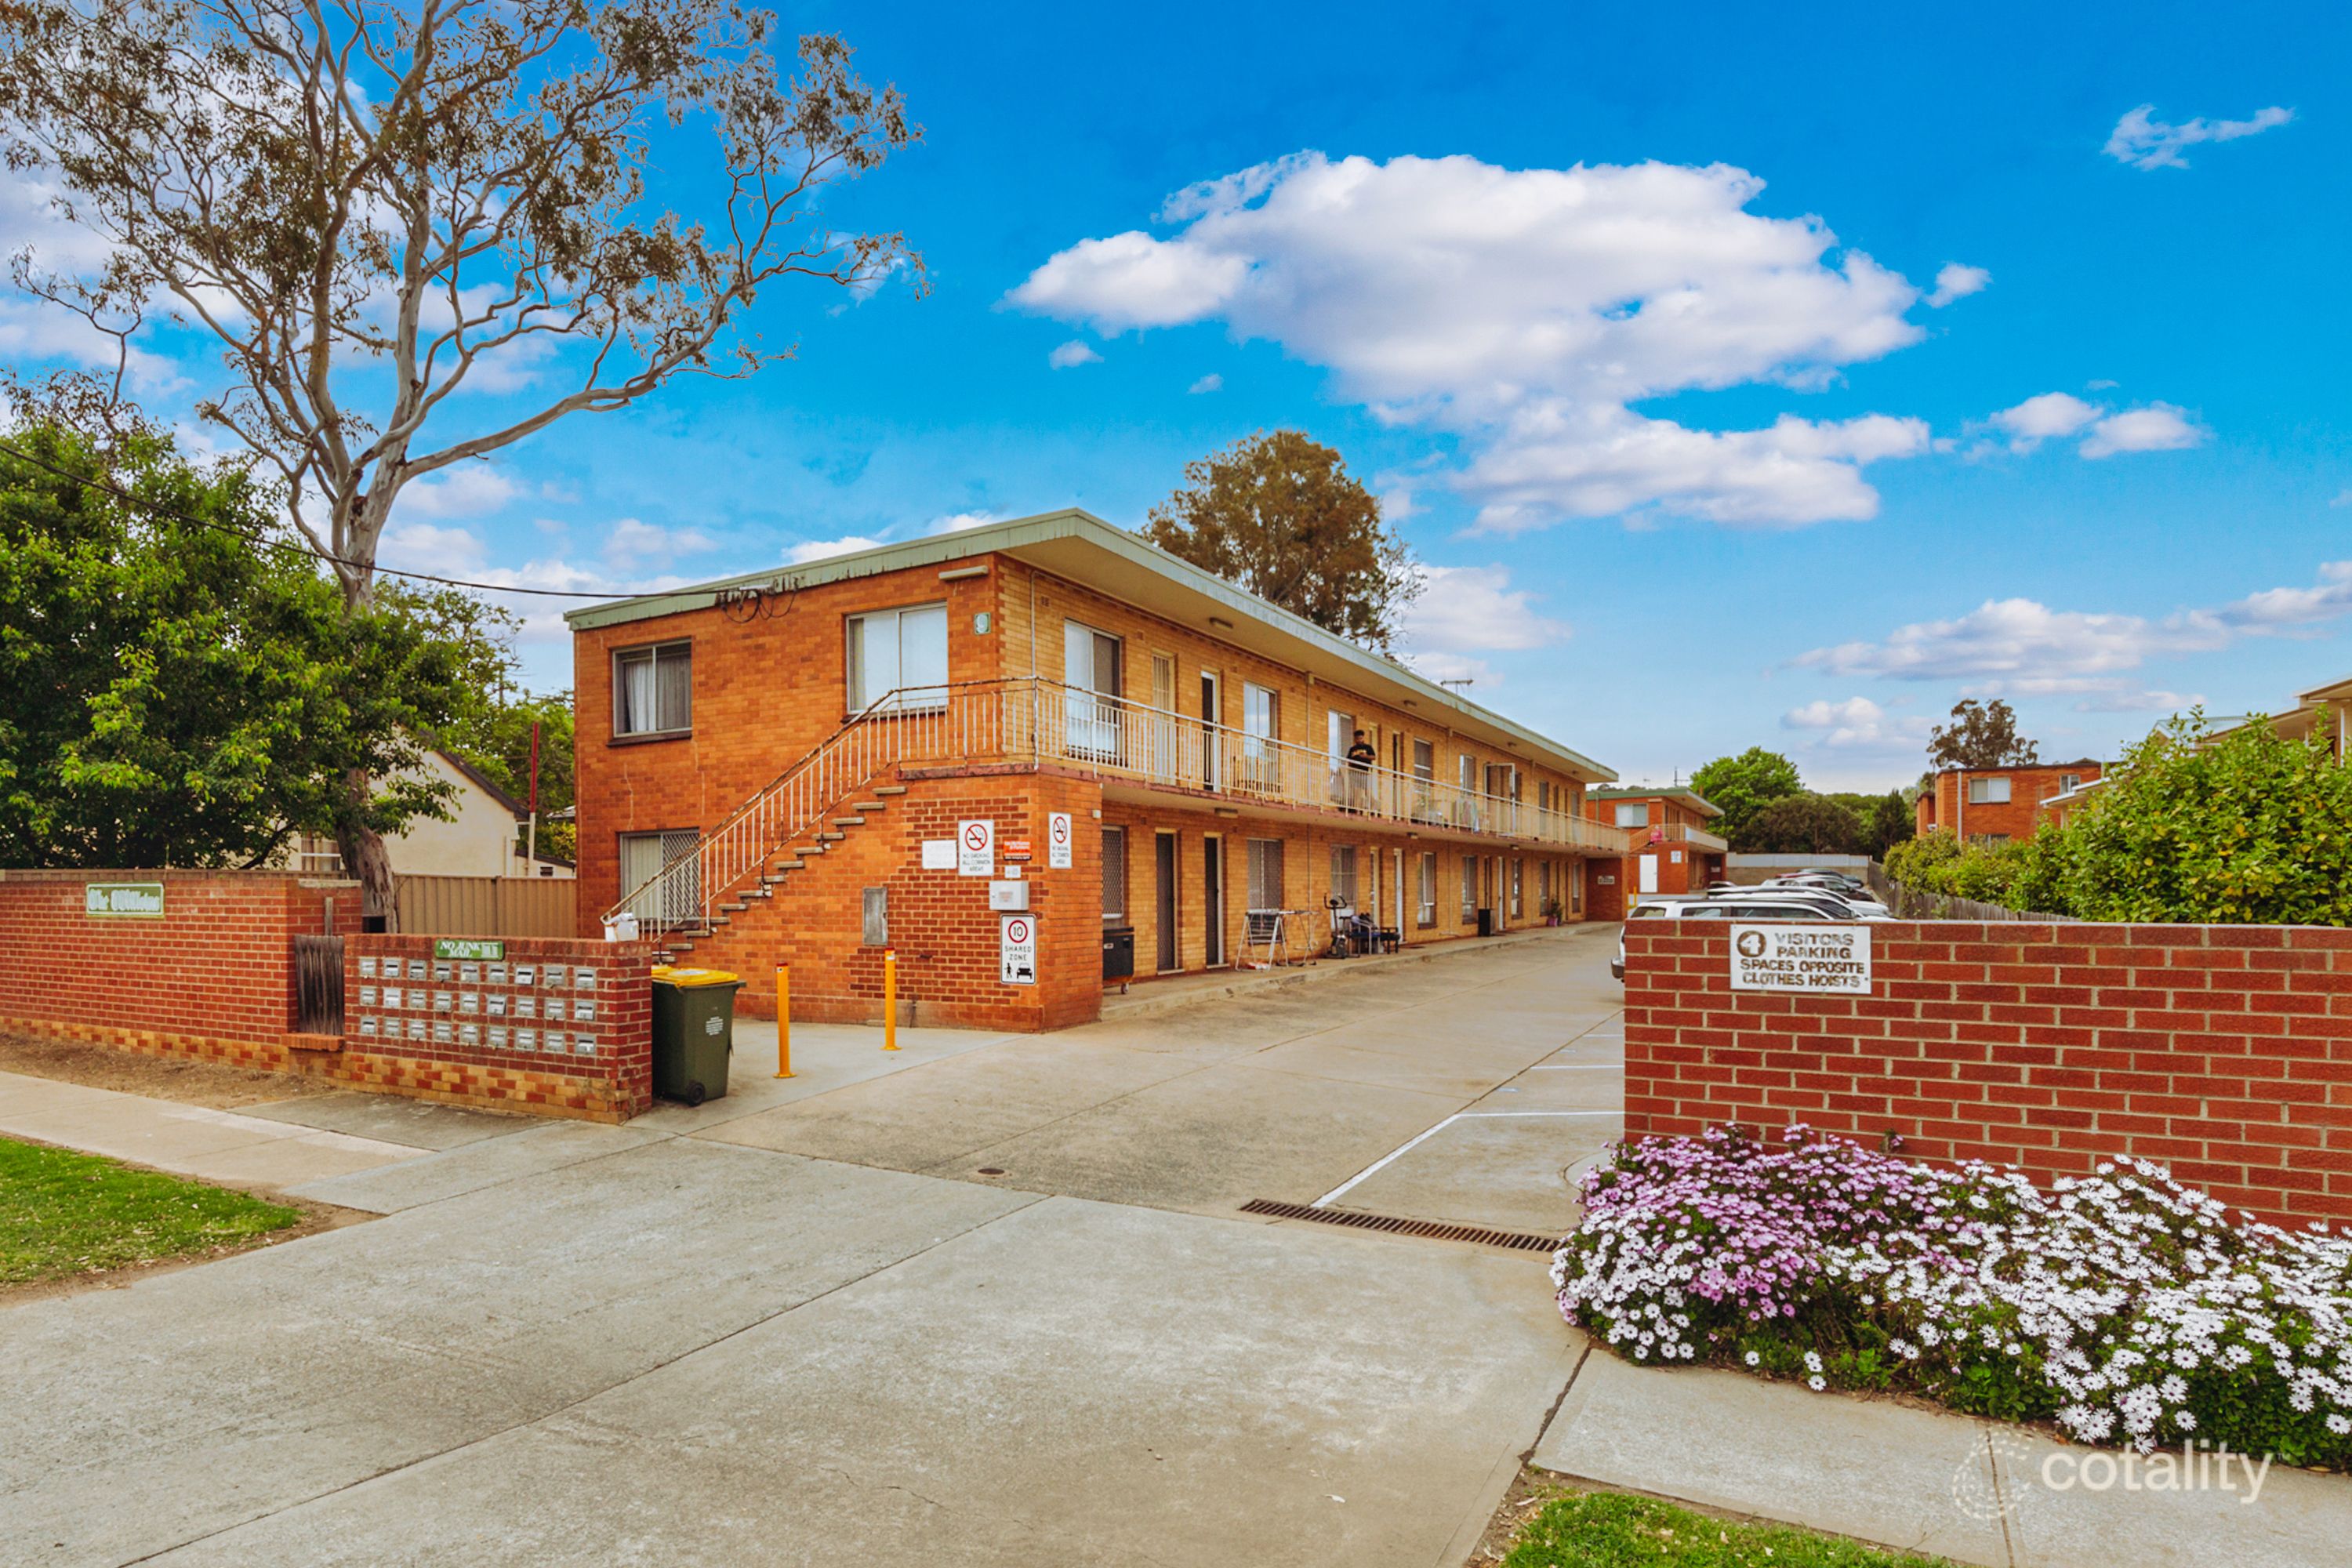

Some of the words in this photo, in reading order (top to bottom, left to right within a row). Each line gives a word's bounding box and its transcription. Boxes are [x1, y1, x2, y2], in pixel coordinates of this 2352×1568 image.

[1012, 926, 1023, 937] 10
[440, 942, 456, 950] NO
[458, 942, 481, 950] JUNK
[1739, 933, 1762, 956] 4
[1774, 932, 1854, 946] VISITORS
[448, 949, 472, 957] MAIL
[1777, 946, 1852, 960] PARKING
[1740, 958, 1795, 971] SPACES
[1799, 960, 1865, 975] OPPOSITE
[1743, 972, 1805, 985] CLOTHES
[1809, 974, 1860, 988] HOISTS
